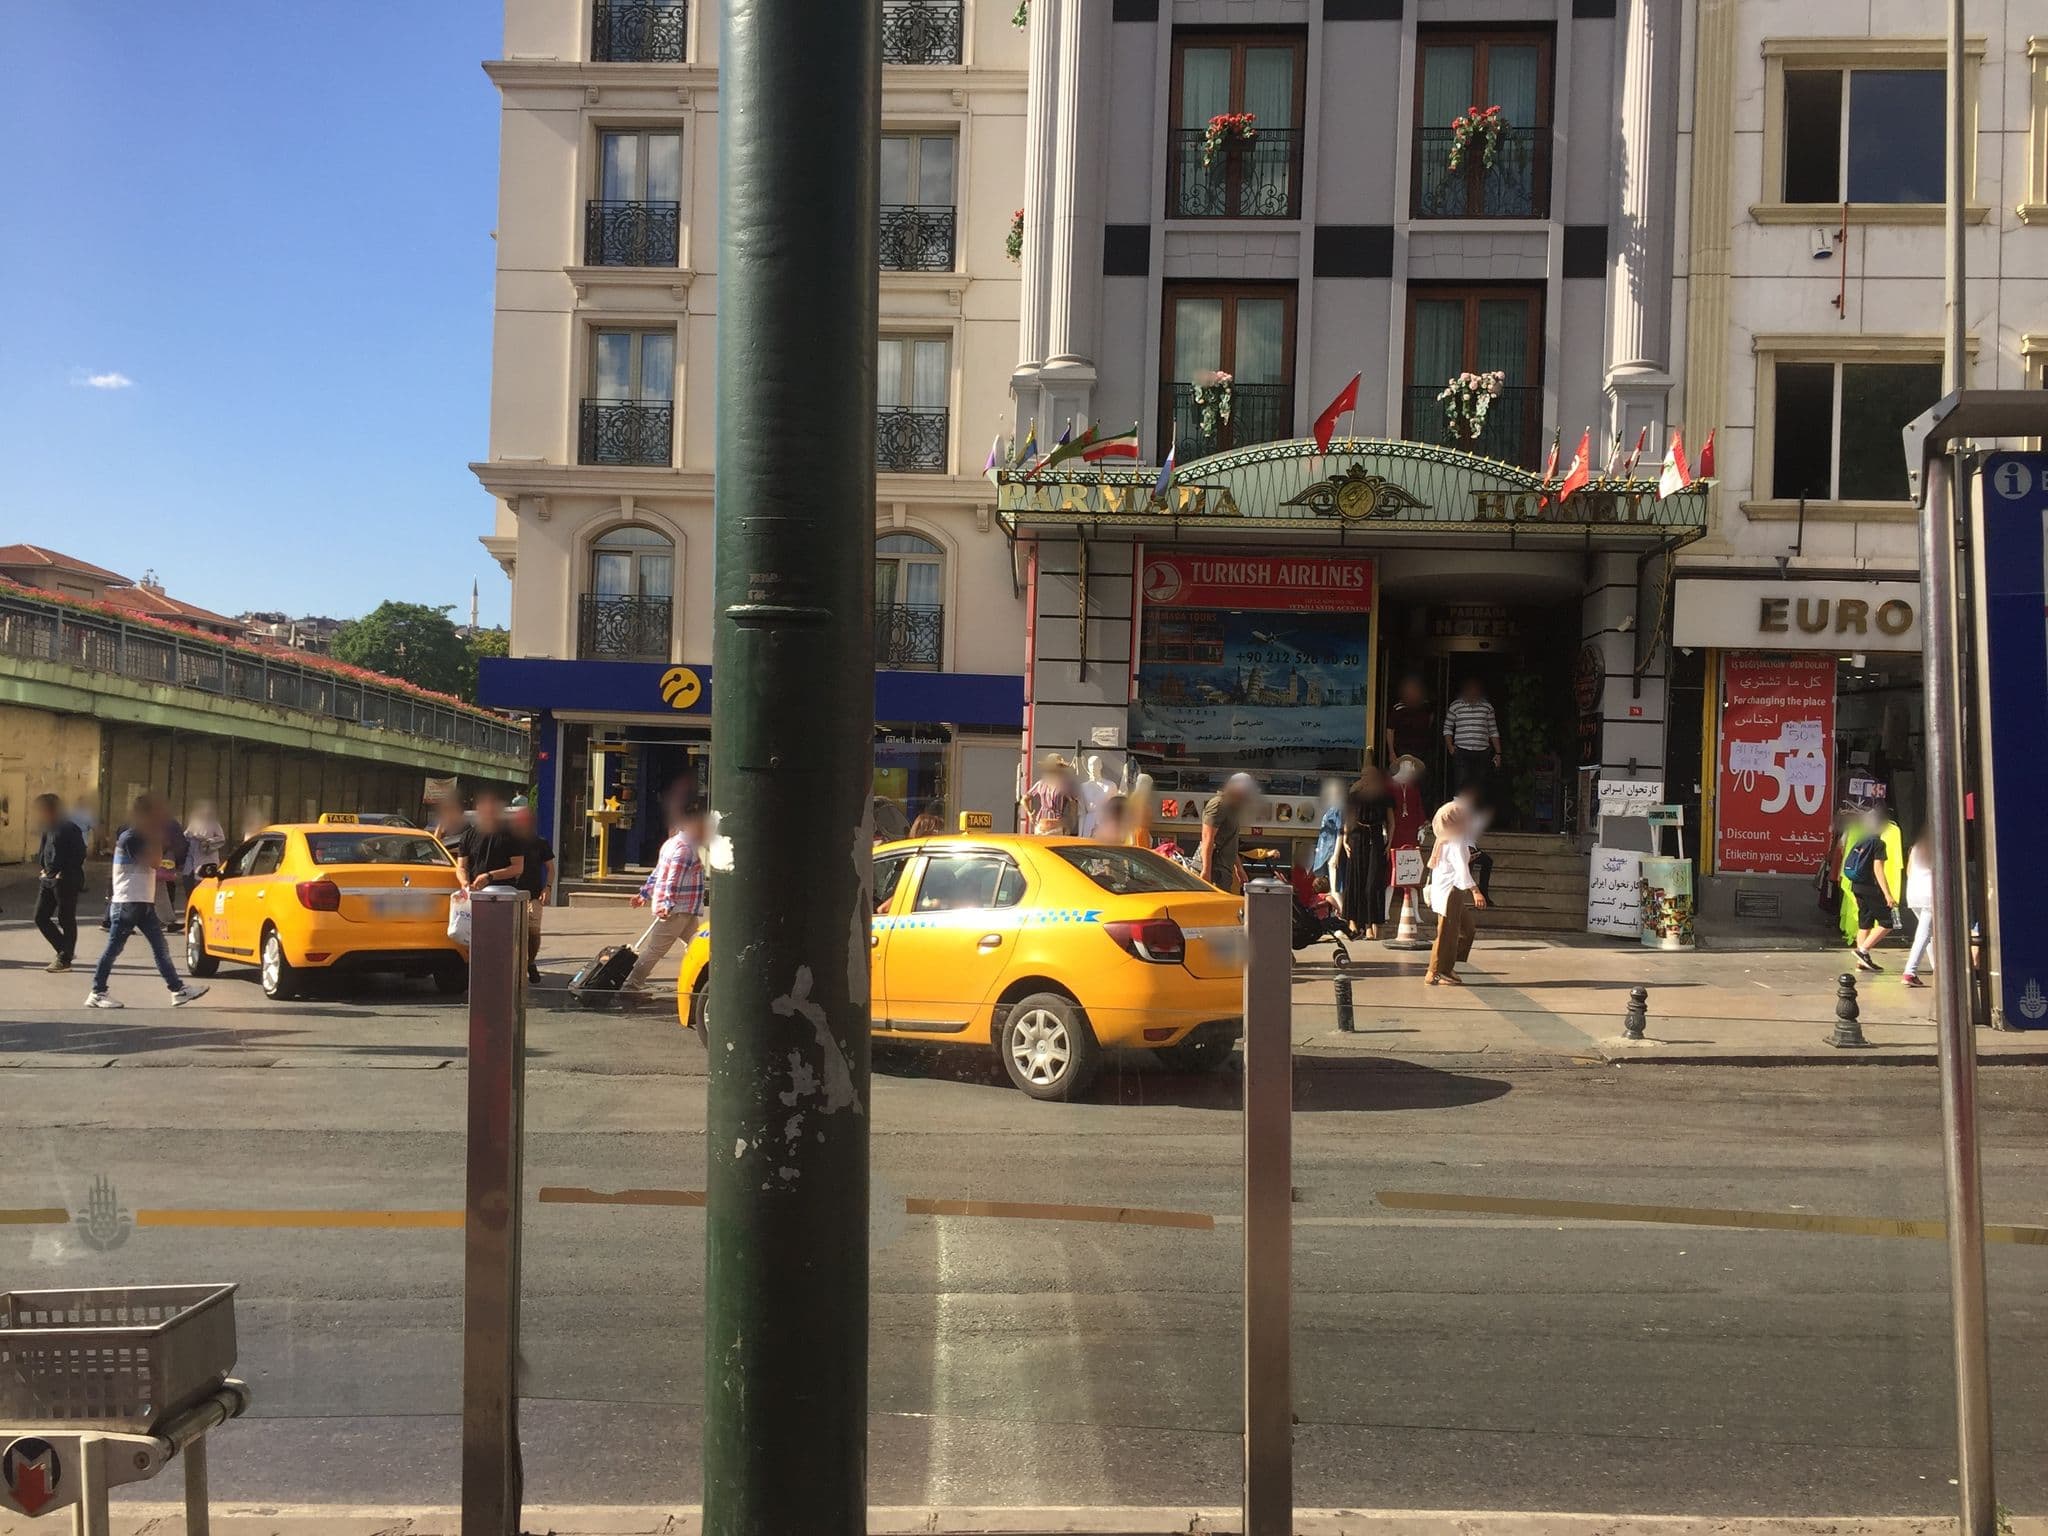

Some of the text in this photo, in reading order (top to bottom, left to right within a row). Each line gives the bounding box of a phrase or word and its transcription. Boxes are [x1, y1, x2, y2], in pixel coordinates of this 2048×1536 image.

[1191, 561, 1363, 588] TURKISH AIRLINES
[1759, 597, 1914, 635] EURO
[1236, 651, 1262, 664] +90
[1267, 651, 1290, 664] 212
[1740, 676, 1822, 689] كل ما تشتري
[1733, 695, 1826, 708] For changing the place
[1735, 712, 1778, 727] اجناس
[910, 735, 942, 745] Turkcell
[1727, 827, 1770, 840] Discount
[1780, 830, 1825, 845] تخفيف
[1725, 848, 1758, 860] Etiketin
